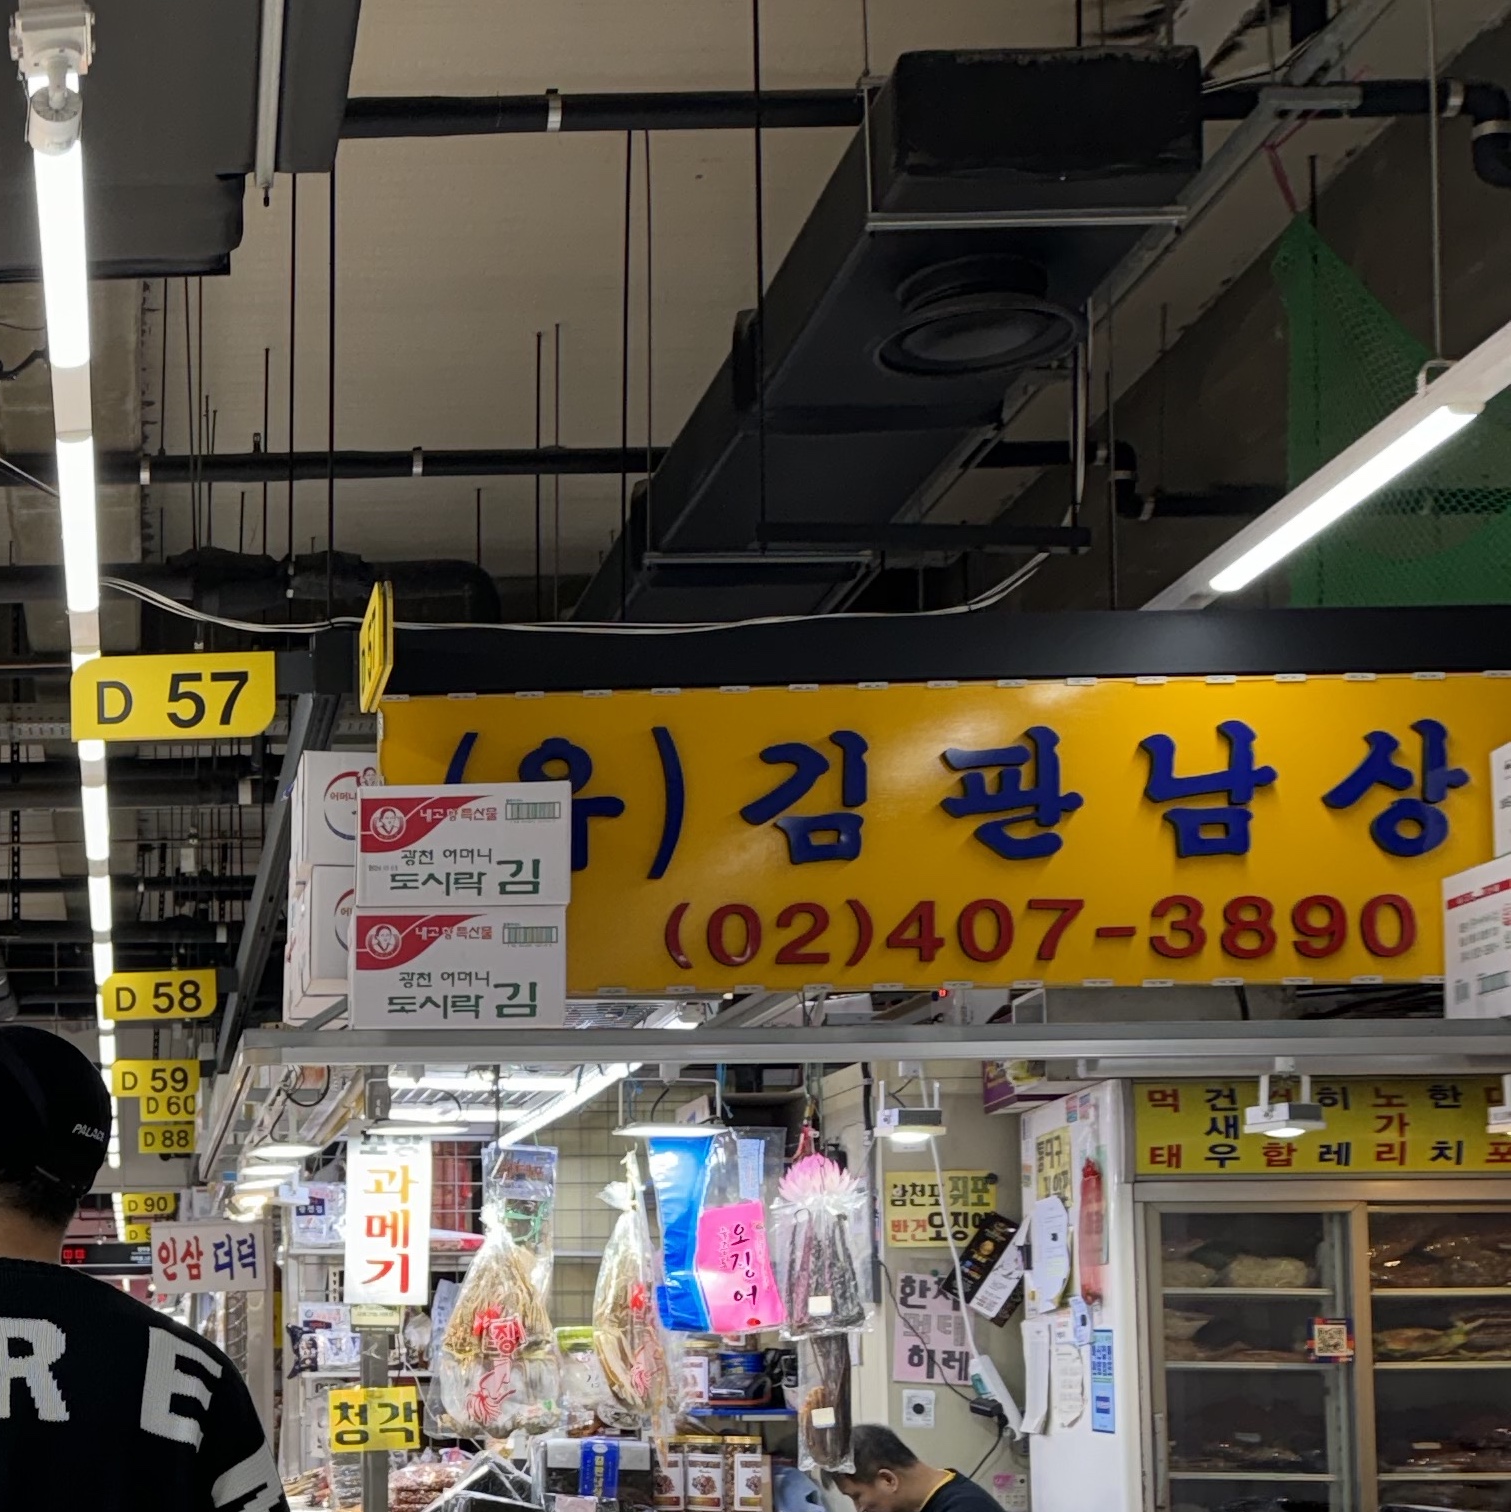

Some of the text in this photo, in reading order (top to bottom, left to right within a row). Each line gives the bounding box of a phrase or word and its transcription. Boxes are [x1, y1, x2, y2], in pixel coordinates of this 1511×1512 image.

[96, 671, 249, 729] D 57
[740, 718, 1470, 864] 김판남상
[401, 848, 493, 866] 광천 어머니
[389, 858, 541, 897] 도시락 김
[664, 893, 1418, 969] (02)407-3890
[115, 979, 203, 1014] D 58
[398, 970, 491, 989] 광천 어머니
[387, 981, 538, 1020] 도시락 김
[121, 1066, 189, 1093] D 59
[145, 1094, 195, 1116] D 60
[143, 1129, 190, 1148] D 88
[127, 1196, 169, 1213] D 90
[361, 1164, 419, 1294] 과메기
[891, 1219, 928, 1242] 반건
[157, 1232, 257, 1282] 인삼 더덕
[729, 1223, 759, 1306] 오징어
[332, 1400, 418, 1447] 청각
